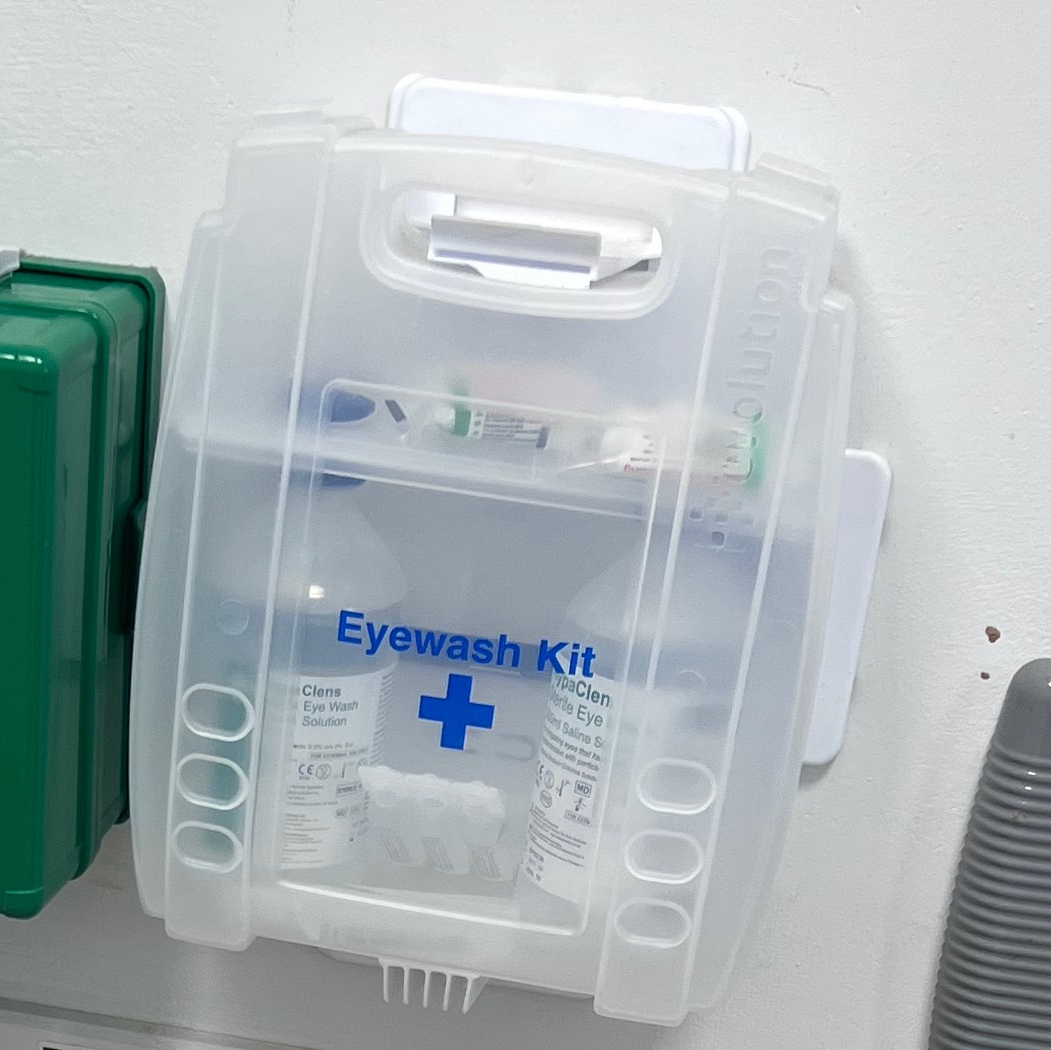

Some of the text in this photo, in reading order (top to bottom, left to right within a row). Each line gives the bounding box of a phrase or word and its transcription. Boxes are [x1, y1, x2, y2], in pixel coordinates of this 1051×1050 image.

[337, 610, 596, 678] Eyewash Kit
[302, 684, 341, 699] Clens
[303, 699, 359, 716] Eye Wash
[577, 703, 603, 727] Eye
[302, 714, 347, 728] Solution
[562, 721, 591, 745] Saline
